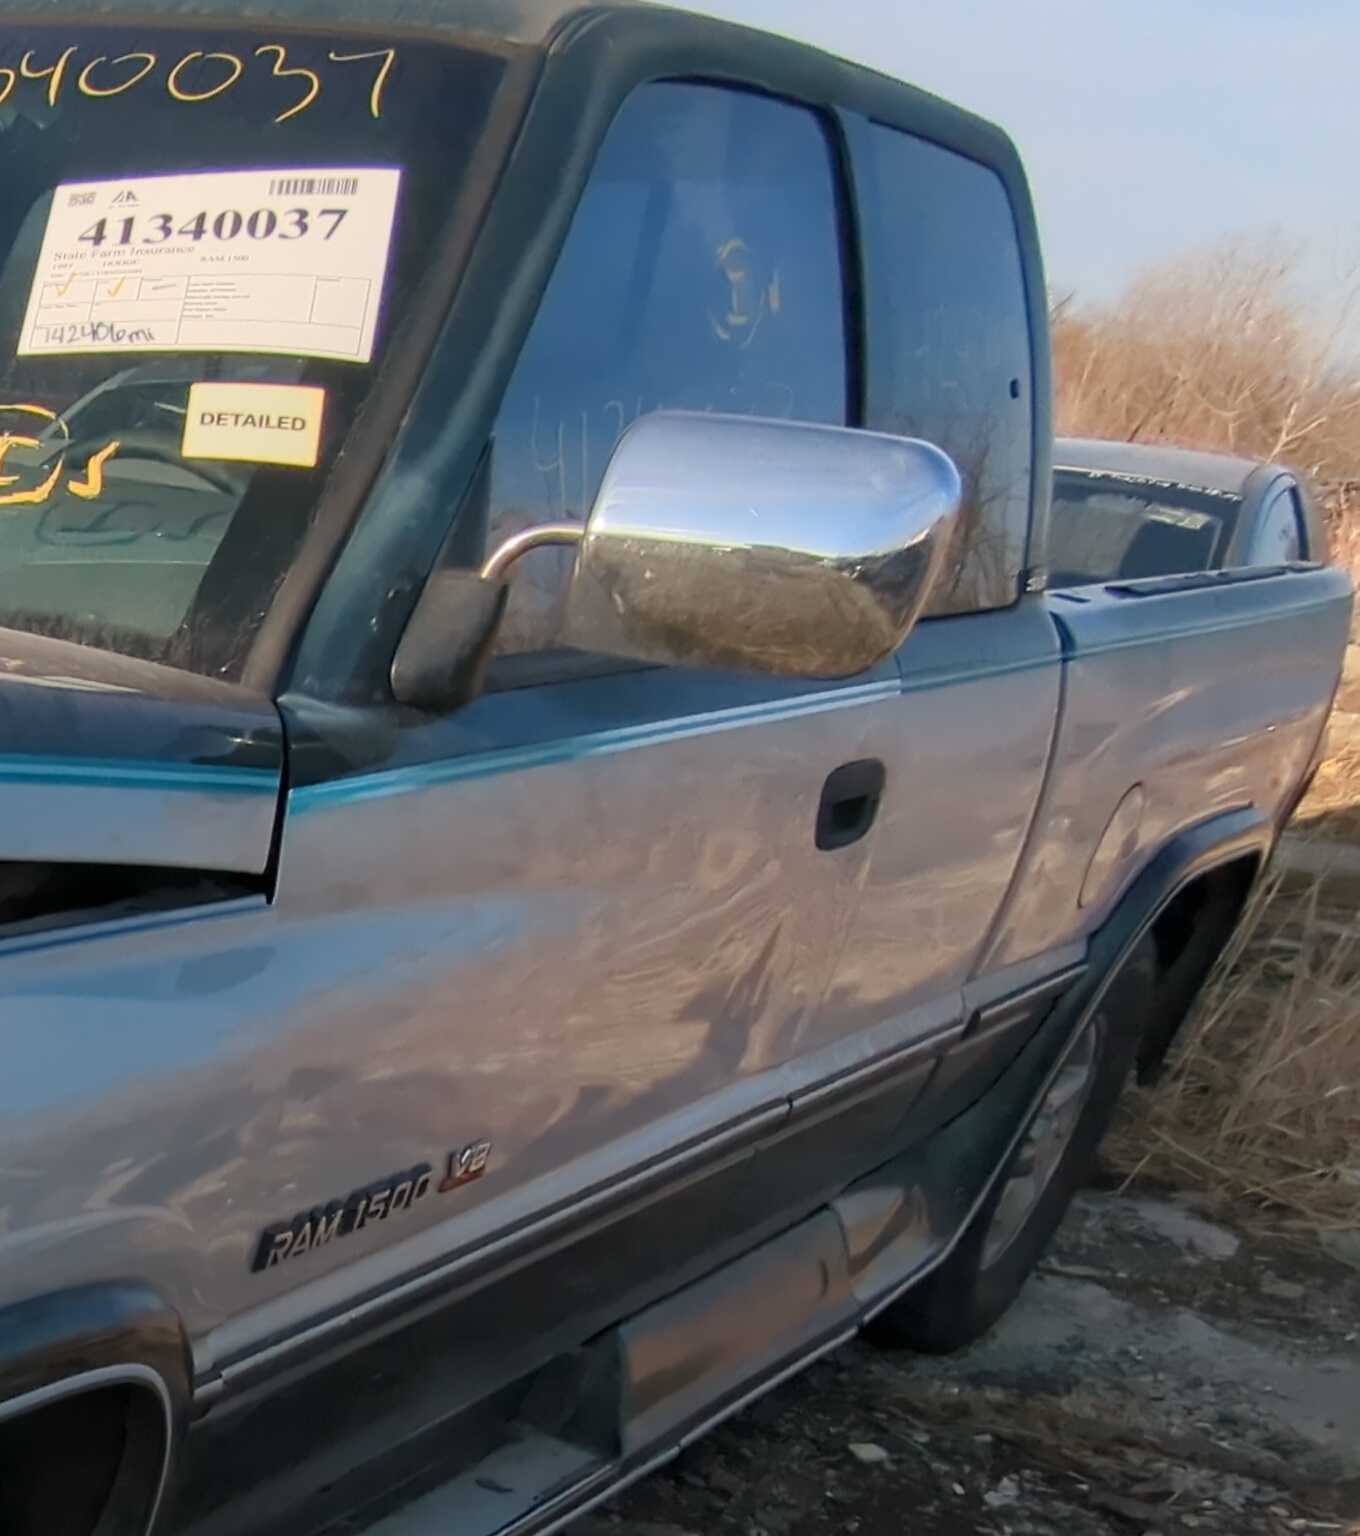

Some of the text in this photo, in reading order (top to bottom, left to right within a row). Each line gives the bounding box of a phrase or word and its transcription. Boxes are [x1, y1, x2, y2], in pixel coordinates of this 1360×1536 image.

[77, 208, 349, 247] 41340037
[91, 249, 127, 260] Farm
[130, 245, 195, 257] Insurance
[199, 411, 307, 432] DETAILED
[251, 1200, 343, 1272] RAM
[343, 1165, 432, 1233] 1500
